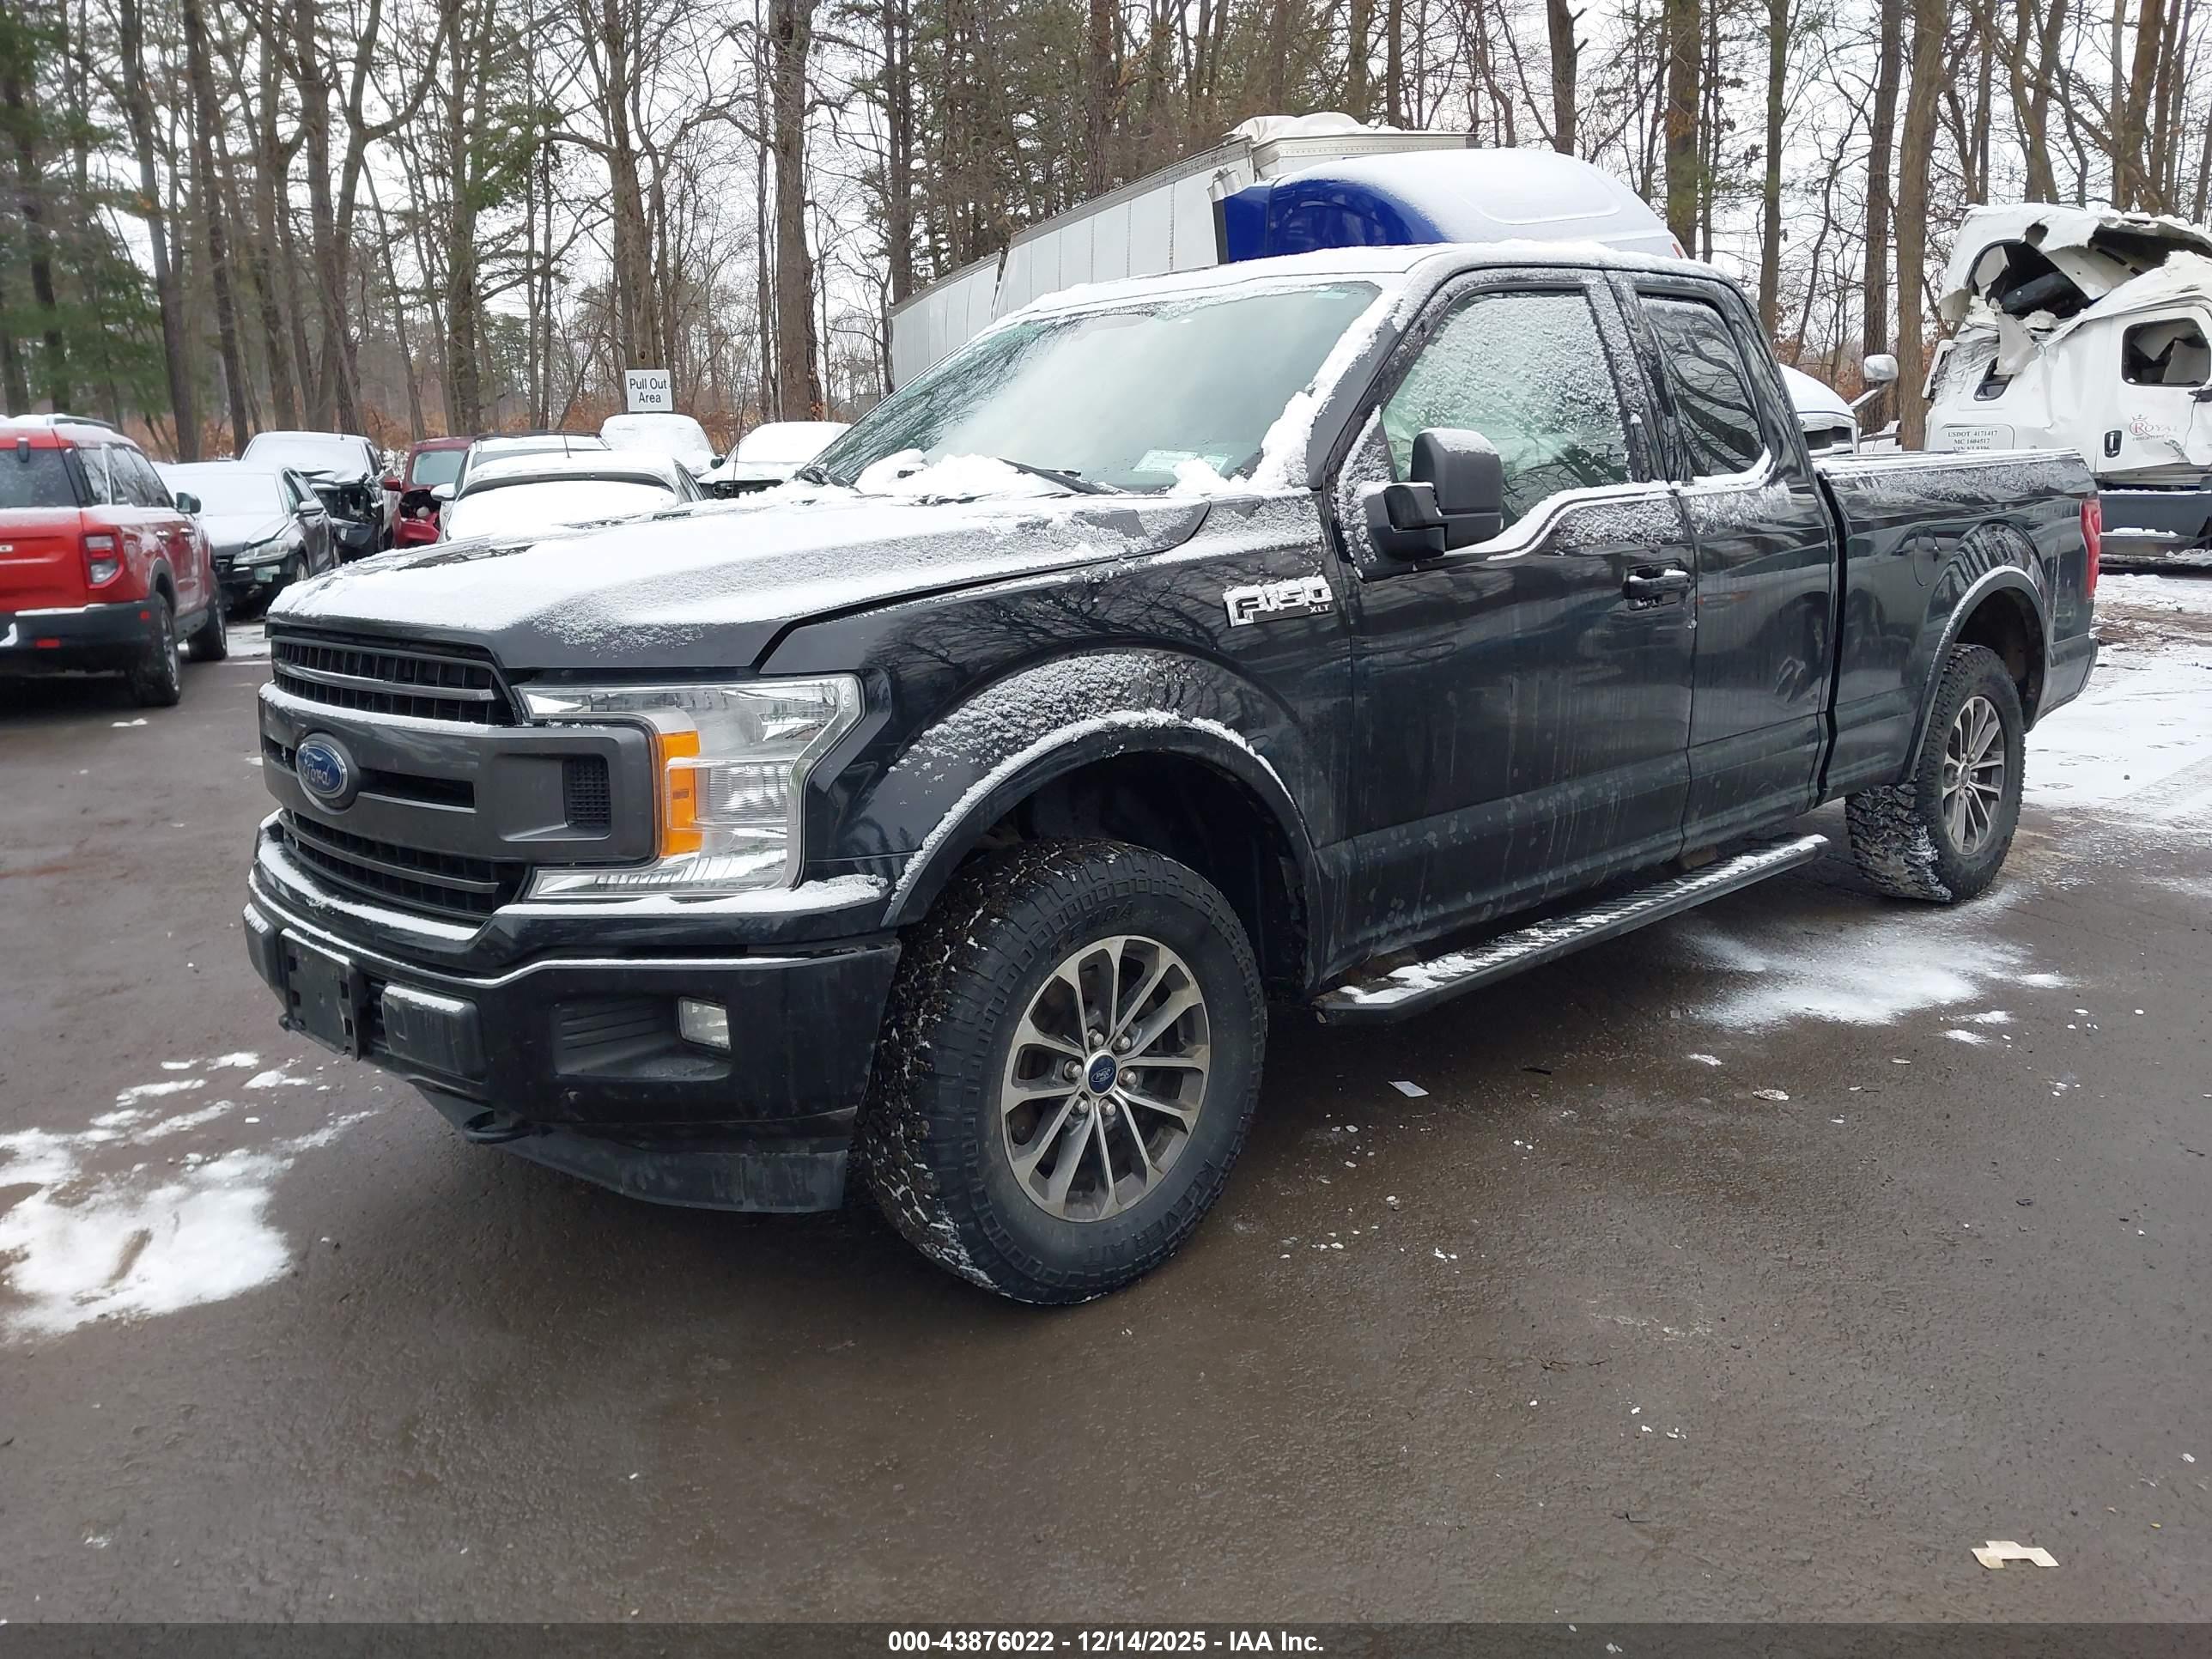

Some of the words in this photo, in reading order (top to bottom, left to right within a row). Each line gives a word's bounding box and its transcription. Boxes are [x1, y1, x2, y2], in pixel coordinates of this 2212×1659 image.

[629, 378, 647, 390] Pull
[649, 377, 667, 390] Out
[638, 392, 661, 404] Area
[1309, 604, 1331, 614] XLT
[303, 751, 331, 787] Ford
